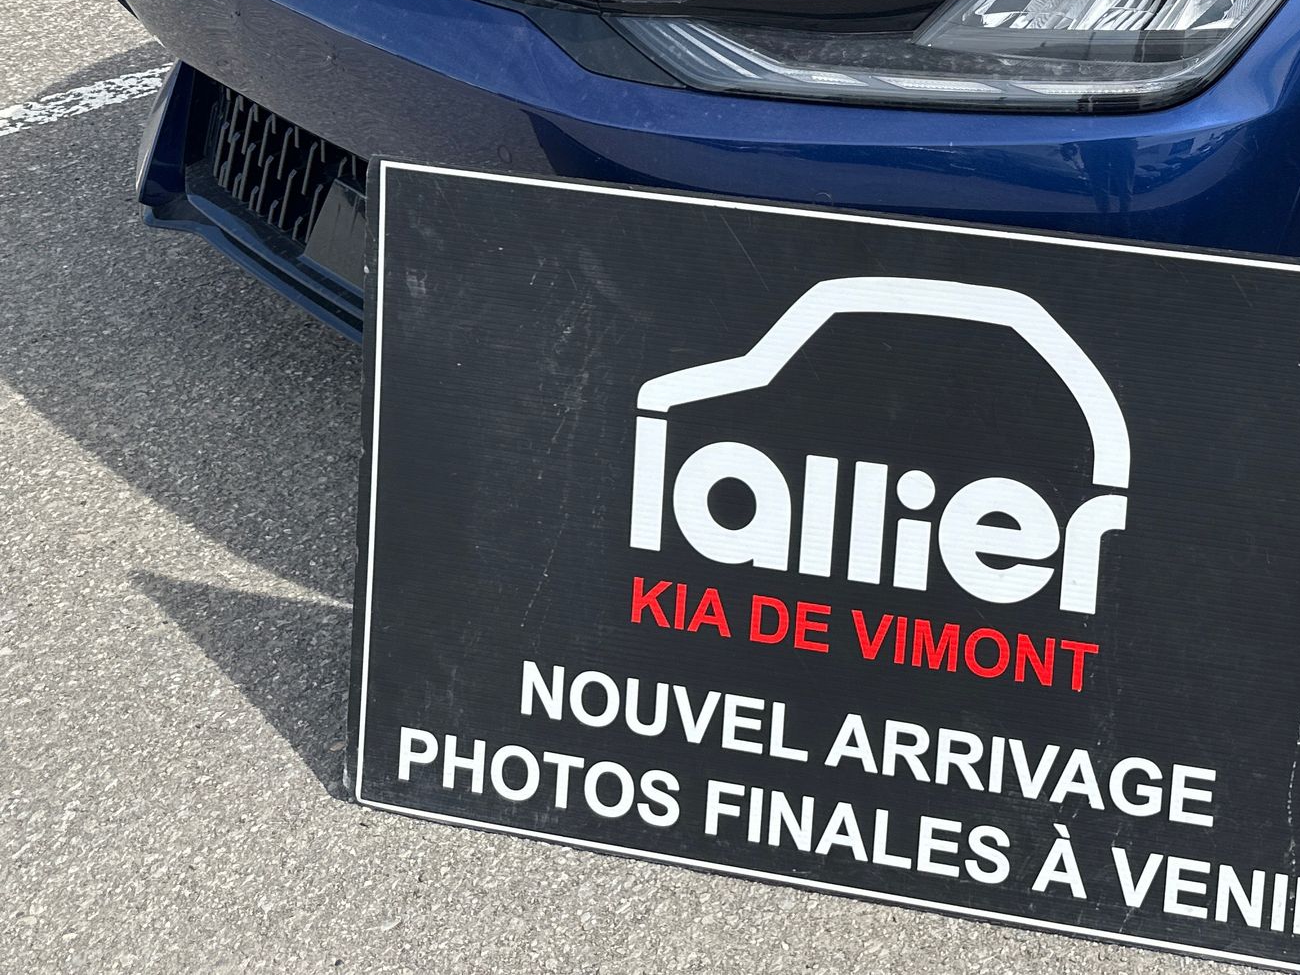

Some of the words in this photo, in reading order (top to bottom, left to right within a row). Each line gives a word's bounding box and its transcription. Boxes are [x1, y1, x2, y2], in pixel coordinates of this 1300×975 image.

[629, 416, 1129, 615] lallier
[630, 576, 732, 638] KIA
[749, 594, 832, 653] DE
[851, 609, 1101, 692] VIMONT
[398, 726, 680, 827] PHOTOS
[704, 779, 1011, 885] FINALES
[1031, 822, 1088, 900] À
[520, 660, 809, 763] NOUVEL
[824, 713, 1217, 829] ARRIVAGE
